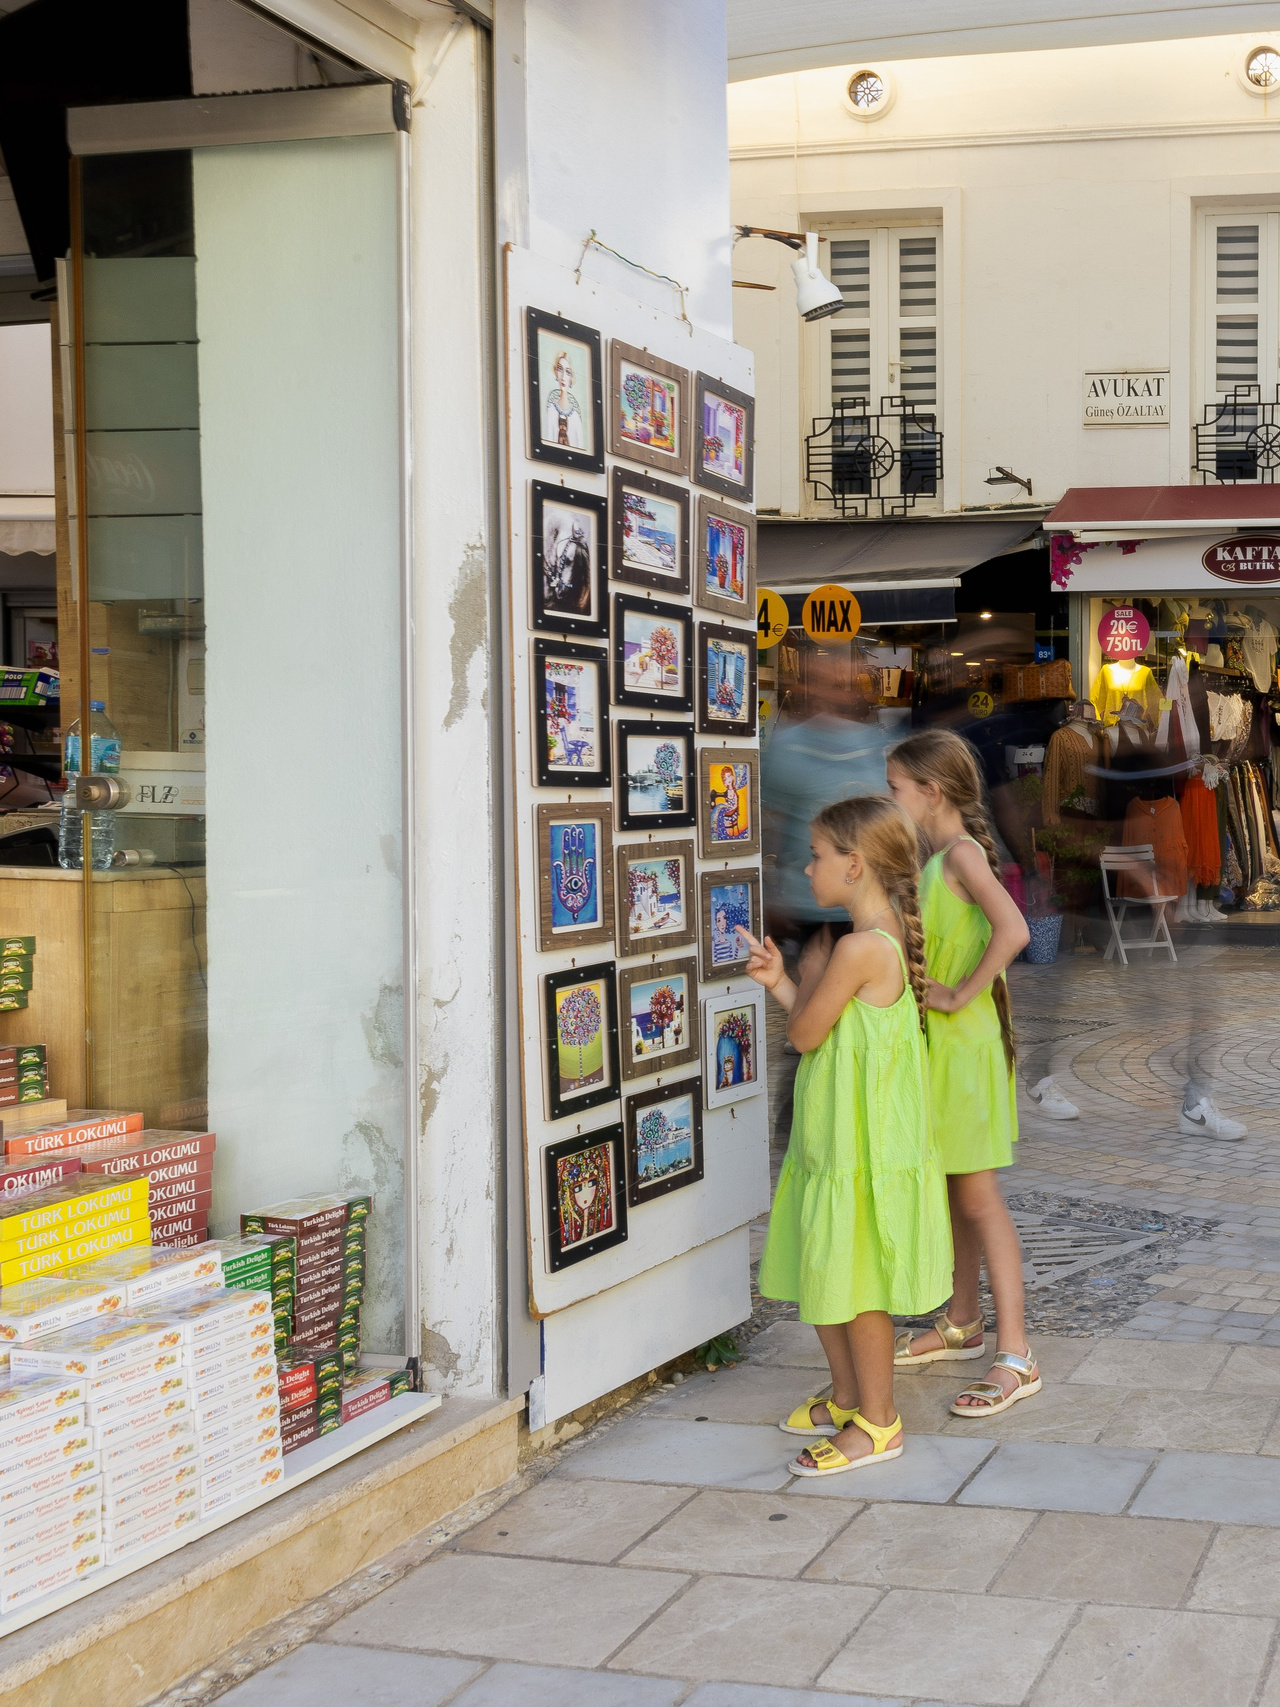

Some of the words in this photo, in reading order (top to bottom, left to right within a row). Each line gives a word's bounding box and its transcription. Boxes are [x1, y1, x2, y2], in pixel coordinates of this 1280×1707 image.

[1087, 378, 1164, 398] AVUKAT
[1086, 406, 1114, 419] Güneş
[1116, 402, 1166, 416] ÖZALTAY
[1240, 560, 1275, 570] BUTİK
[810, 600, 852, 632] MAX
[1110, 620, 1138, 635] 20€
[971, 694, 990, 708] 24
[136, 784, 179, 804] FLZ
[25, 1132, 65, 1154] TÜRK
[68, 1120, 127, 1144] LOKUMU
[102, 1156, 140, 1176] TÜRK
[143, 1142, 200, 1166] LOKUMU
[148, 1160, 198, 1184] OKUMU
[148, 1180, 196, 1204] OKUMU
[20, 1208, 62, 1232] TÜRK
[68, 1187, 132, 1220] LOKUMU
[302, 1216, 324, 1228] Turkish
[325, 1208, 345, 1220] Delight
[16, 1228, 60, 1254] TÜRK
[64, 1206, 130, 1240] LOKUMU
[300, 1234, 321, 1246] Turkish
[322, 1228, 340, 1240] Delight
[18, 1249, 62, 1276] TÜRK
[68, 1228, 133, 1262] LOKUMU
[222, 1260, 246, 1272] Turkish
[246, 1252, 268, 1264] Delight
[299, 1253, 320, 1266] Turkish
[320, 1246, 340, 1258] Delight
[246, 1273, 268, 1286] Delight
[300, 1272, 320, 1284] Turkish
[322, 1264, 340, 1277] Delight
[300, 1291, 320, 1304] Turkish
[322, 1283, 340, 1296] Delight
[301, 1310, 320, 1322] Turkish
[322, 1301, 340, 1314] Delight
[292, 1329, 314, 1342] Turkish
[314, 1321, 334, 1334] Delight
[286, 1370, 310, 1384] Delight
[291, 1386, 312, 1400] Delight
[348, 1398, 368, 1412] Turkish
[369, 1388, 388, 1402] Delight
[292, 1406, 313, 1422] Delight
[292, 1426, 314, 1442] Delight
